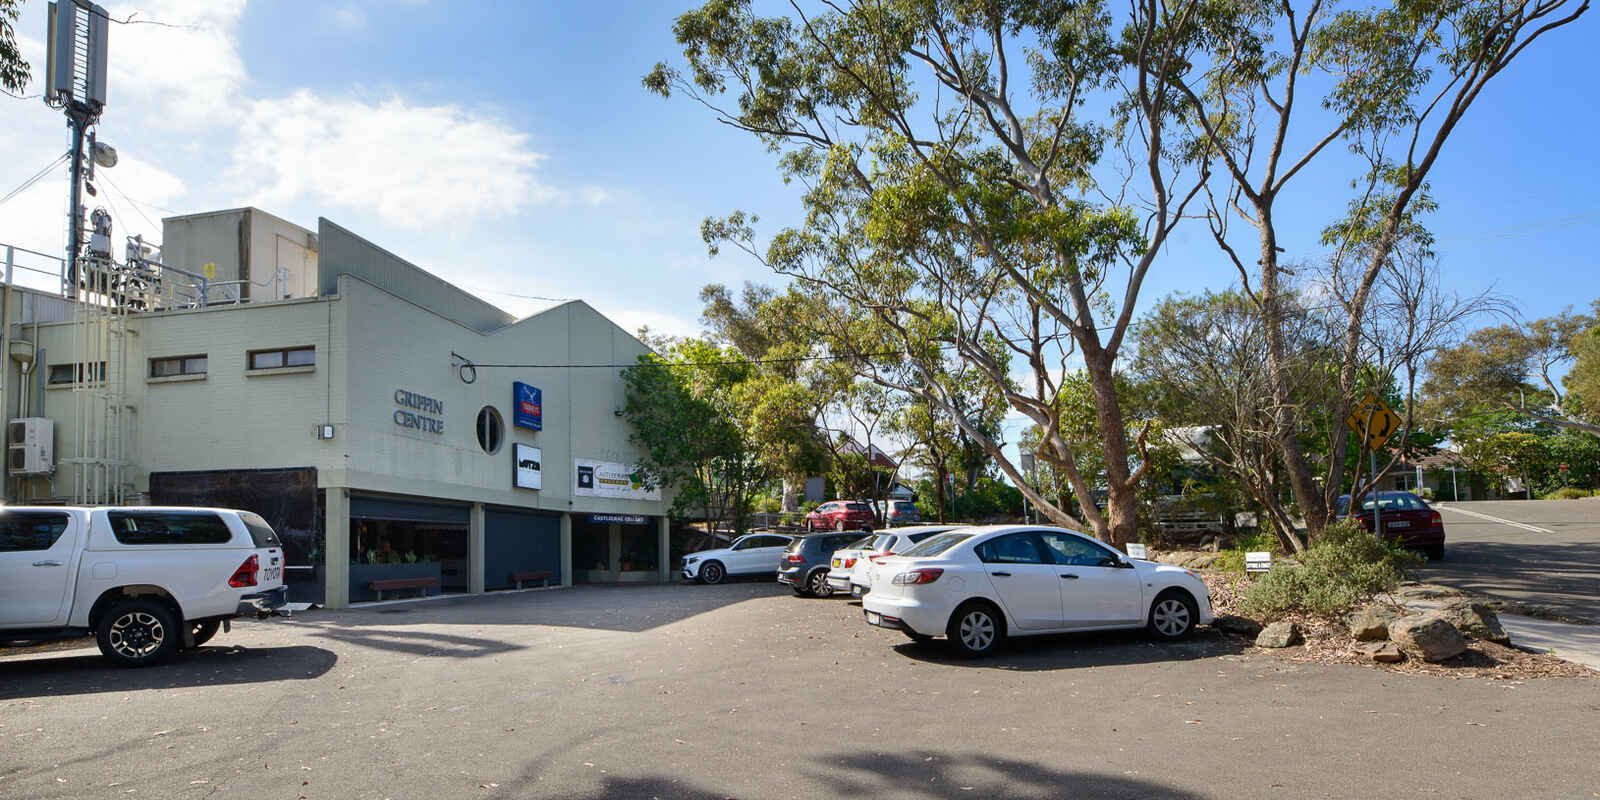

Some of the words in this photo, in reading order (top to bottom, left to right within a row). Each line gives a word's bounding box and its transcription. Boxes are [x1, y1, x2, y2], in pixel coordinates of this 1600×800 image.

[394, 389, 444, 414] GRIFFIN
[393, 410, 444, 435] CENTRE
[264, 566, 281, 581] TOYOTA
